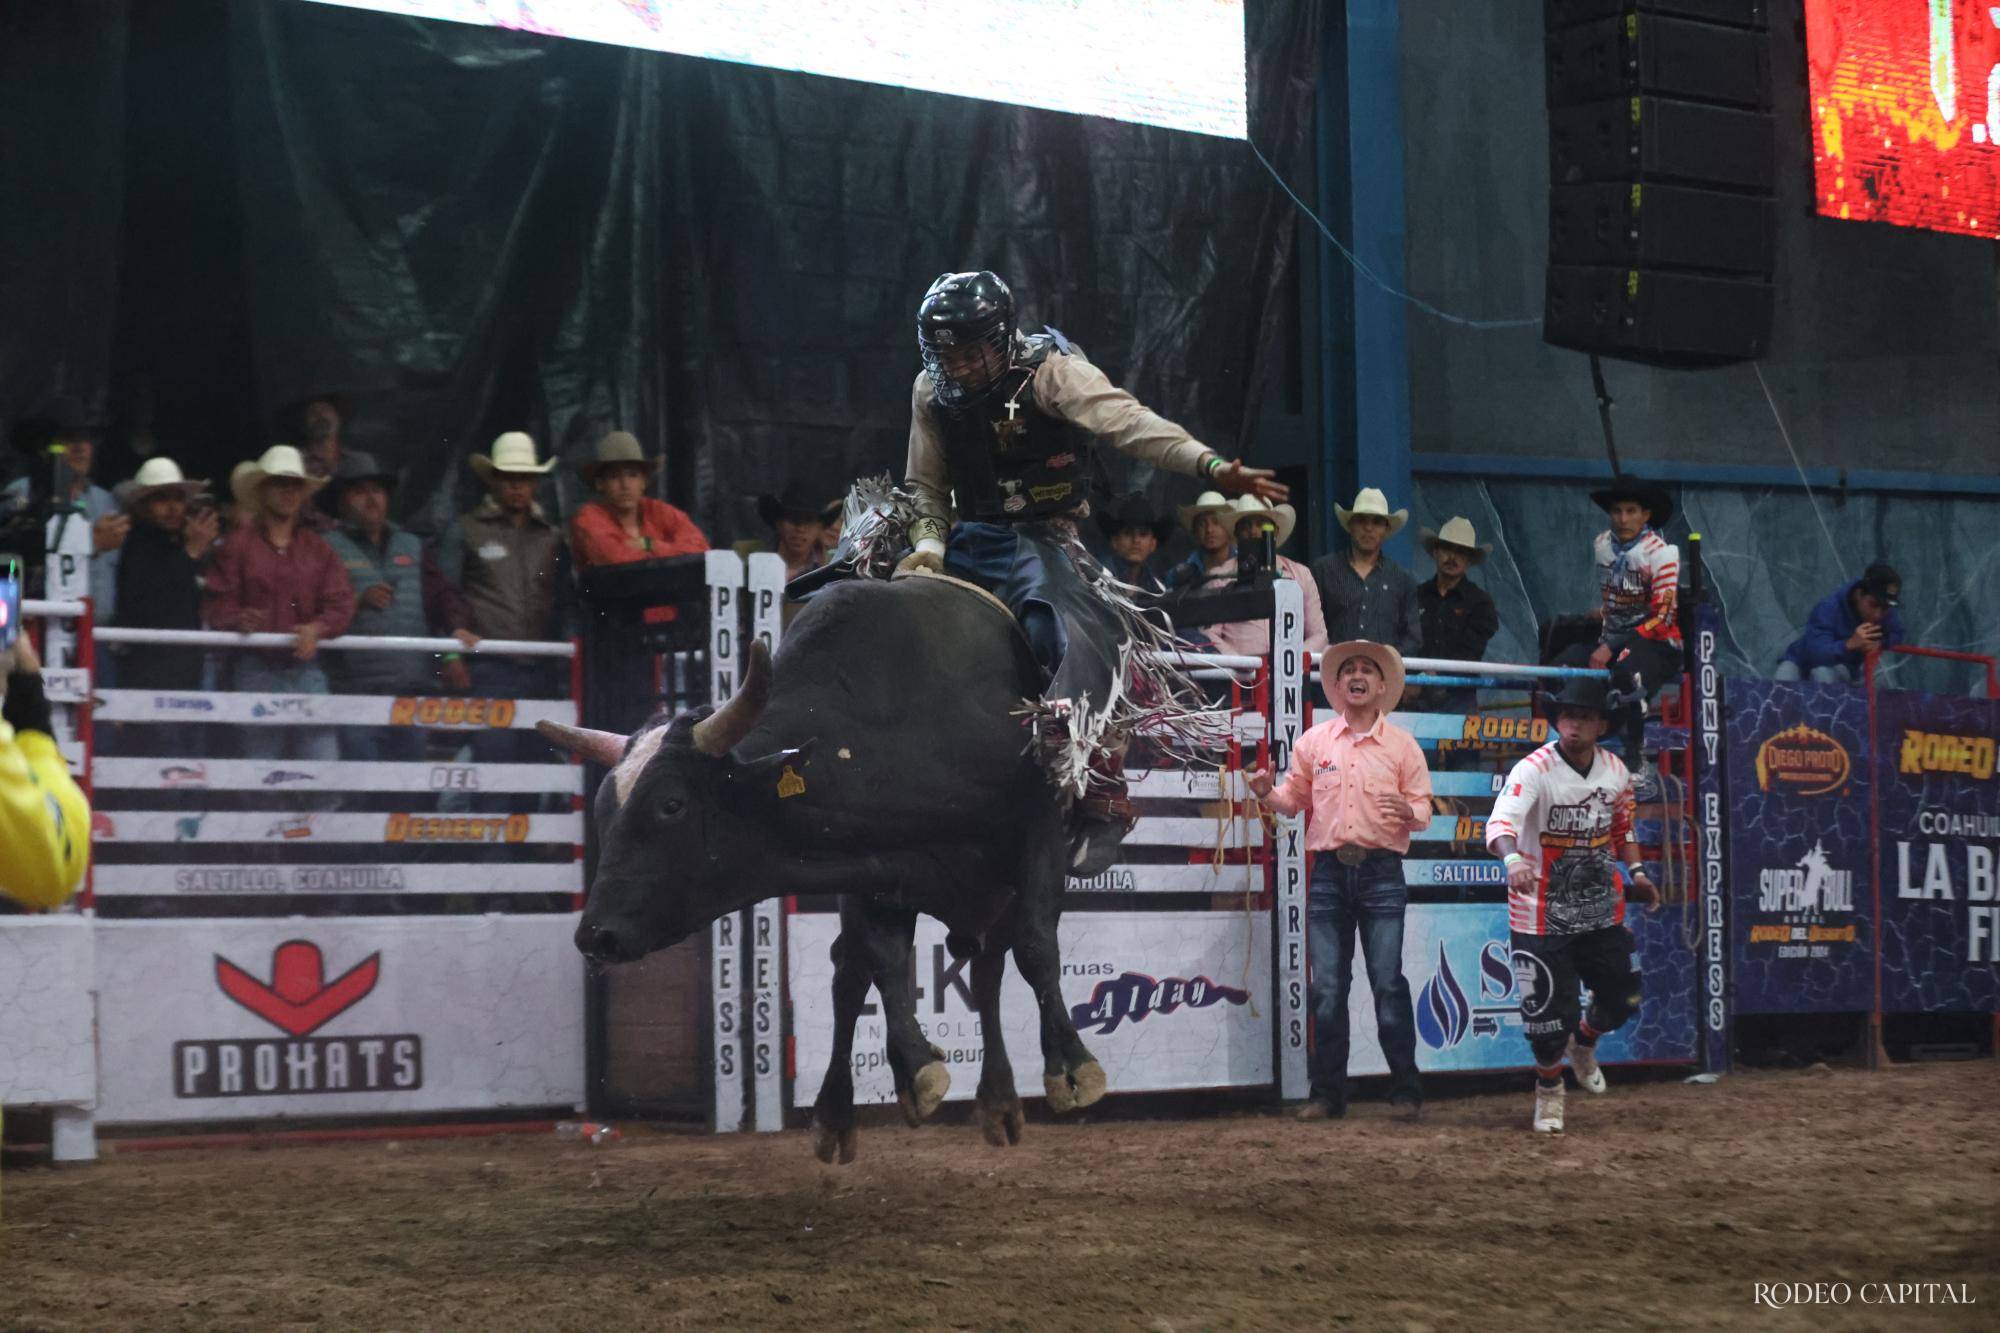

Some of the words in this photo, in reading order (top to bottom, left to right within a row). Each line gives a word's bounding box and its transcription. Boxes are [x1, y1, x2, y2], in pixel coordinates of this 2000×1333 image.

[1282, 611, 1298, 752] PONY
[1701, 631, 1718, 766] PONY
[390, 696, 517, 729] RODEO
[1463, 715, 1549, 742] RODEO
[431, 766, 480, 791] DEL
[1900, 729, 1995, 780] RODEO
[1919, 811, 2000, 838] COAHUIL
[1433, 864, 1507, 885] SALTILLO,
[1759, 868, 1805, 912] SUPER
[1897, 841, 1955, 900] LA
[1287, 812, 1302, 1048] XPRESS
[1705, 793, 1724, 1031] EXPRESS
[1062, 962, 1115, 976] ruas
[719, 915, 734, 1075] RESS
[756, 915, 771, 1075] RESS
[1090, 981, 1206, 1019] Alday
[182, 1040, 417, 1094] PROHATS
